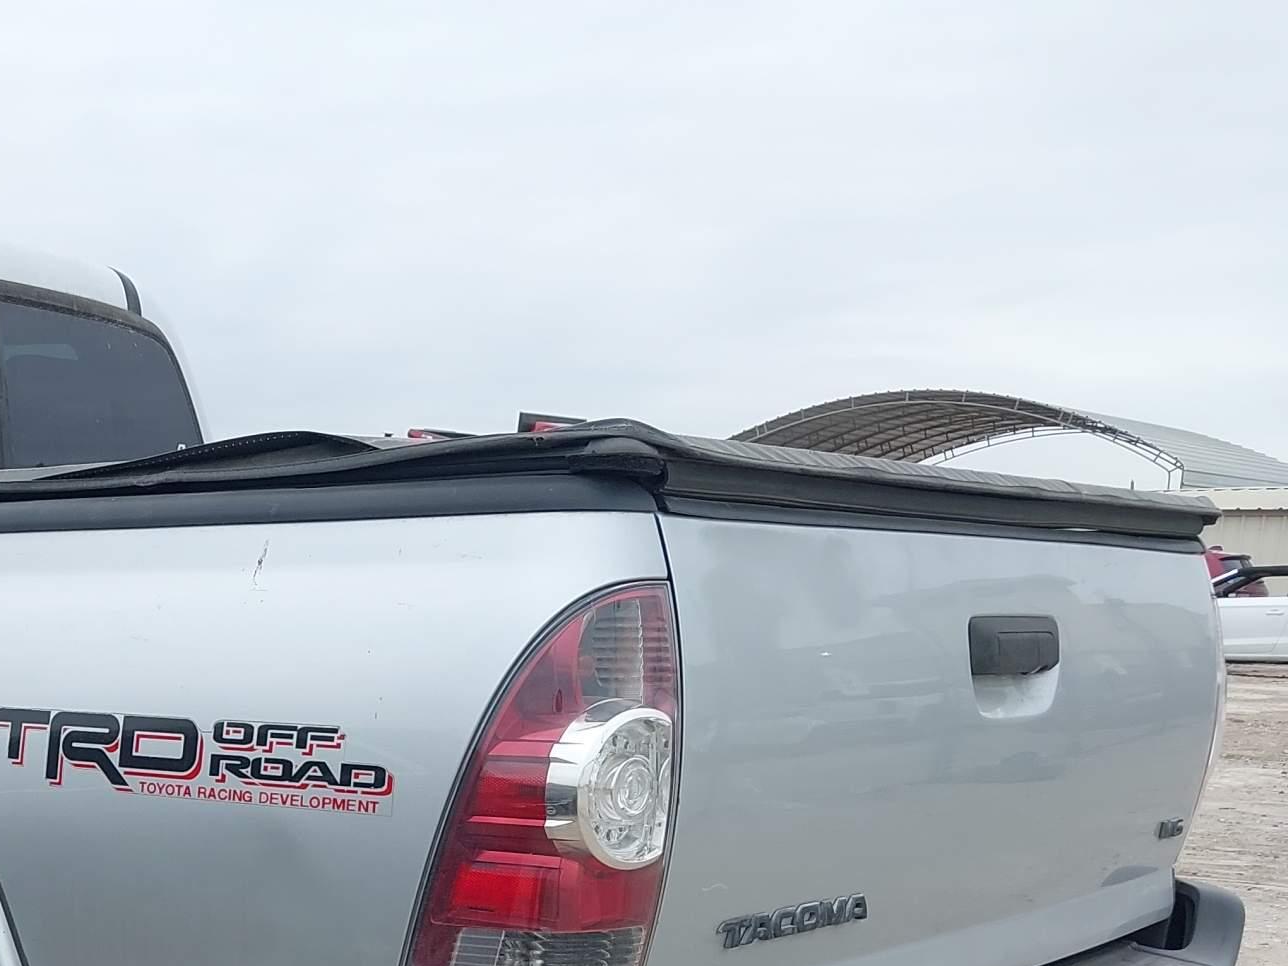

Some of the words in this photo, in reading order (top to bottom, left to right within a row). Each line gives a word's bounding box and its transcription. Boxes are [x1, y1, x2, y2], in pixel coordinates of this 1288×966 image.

[211, 720, 347, 756] OFF
[209, 753, 394, 797] ROAD
[139, 781, 192, 799] TOYOTA
[197, 786, 253, 804] RACING
[258, 791, 380, 815] DEVELOPMENT
[716, 893, 868, 950] TACOMA
